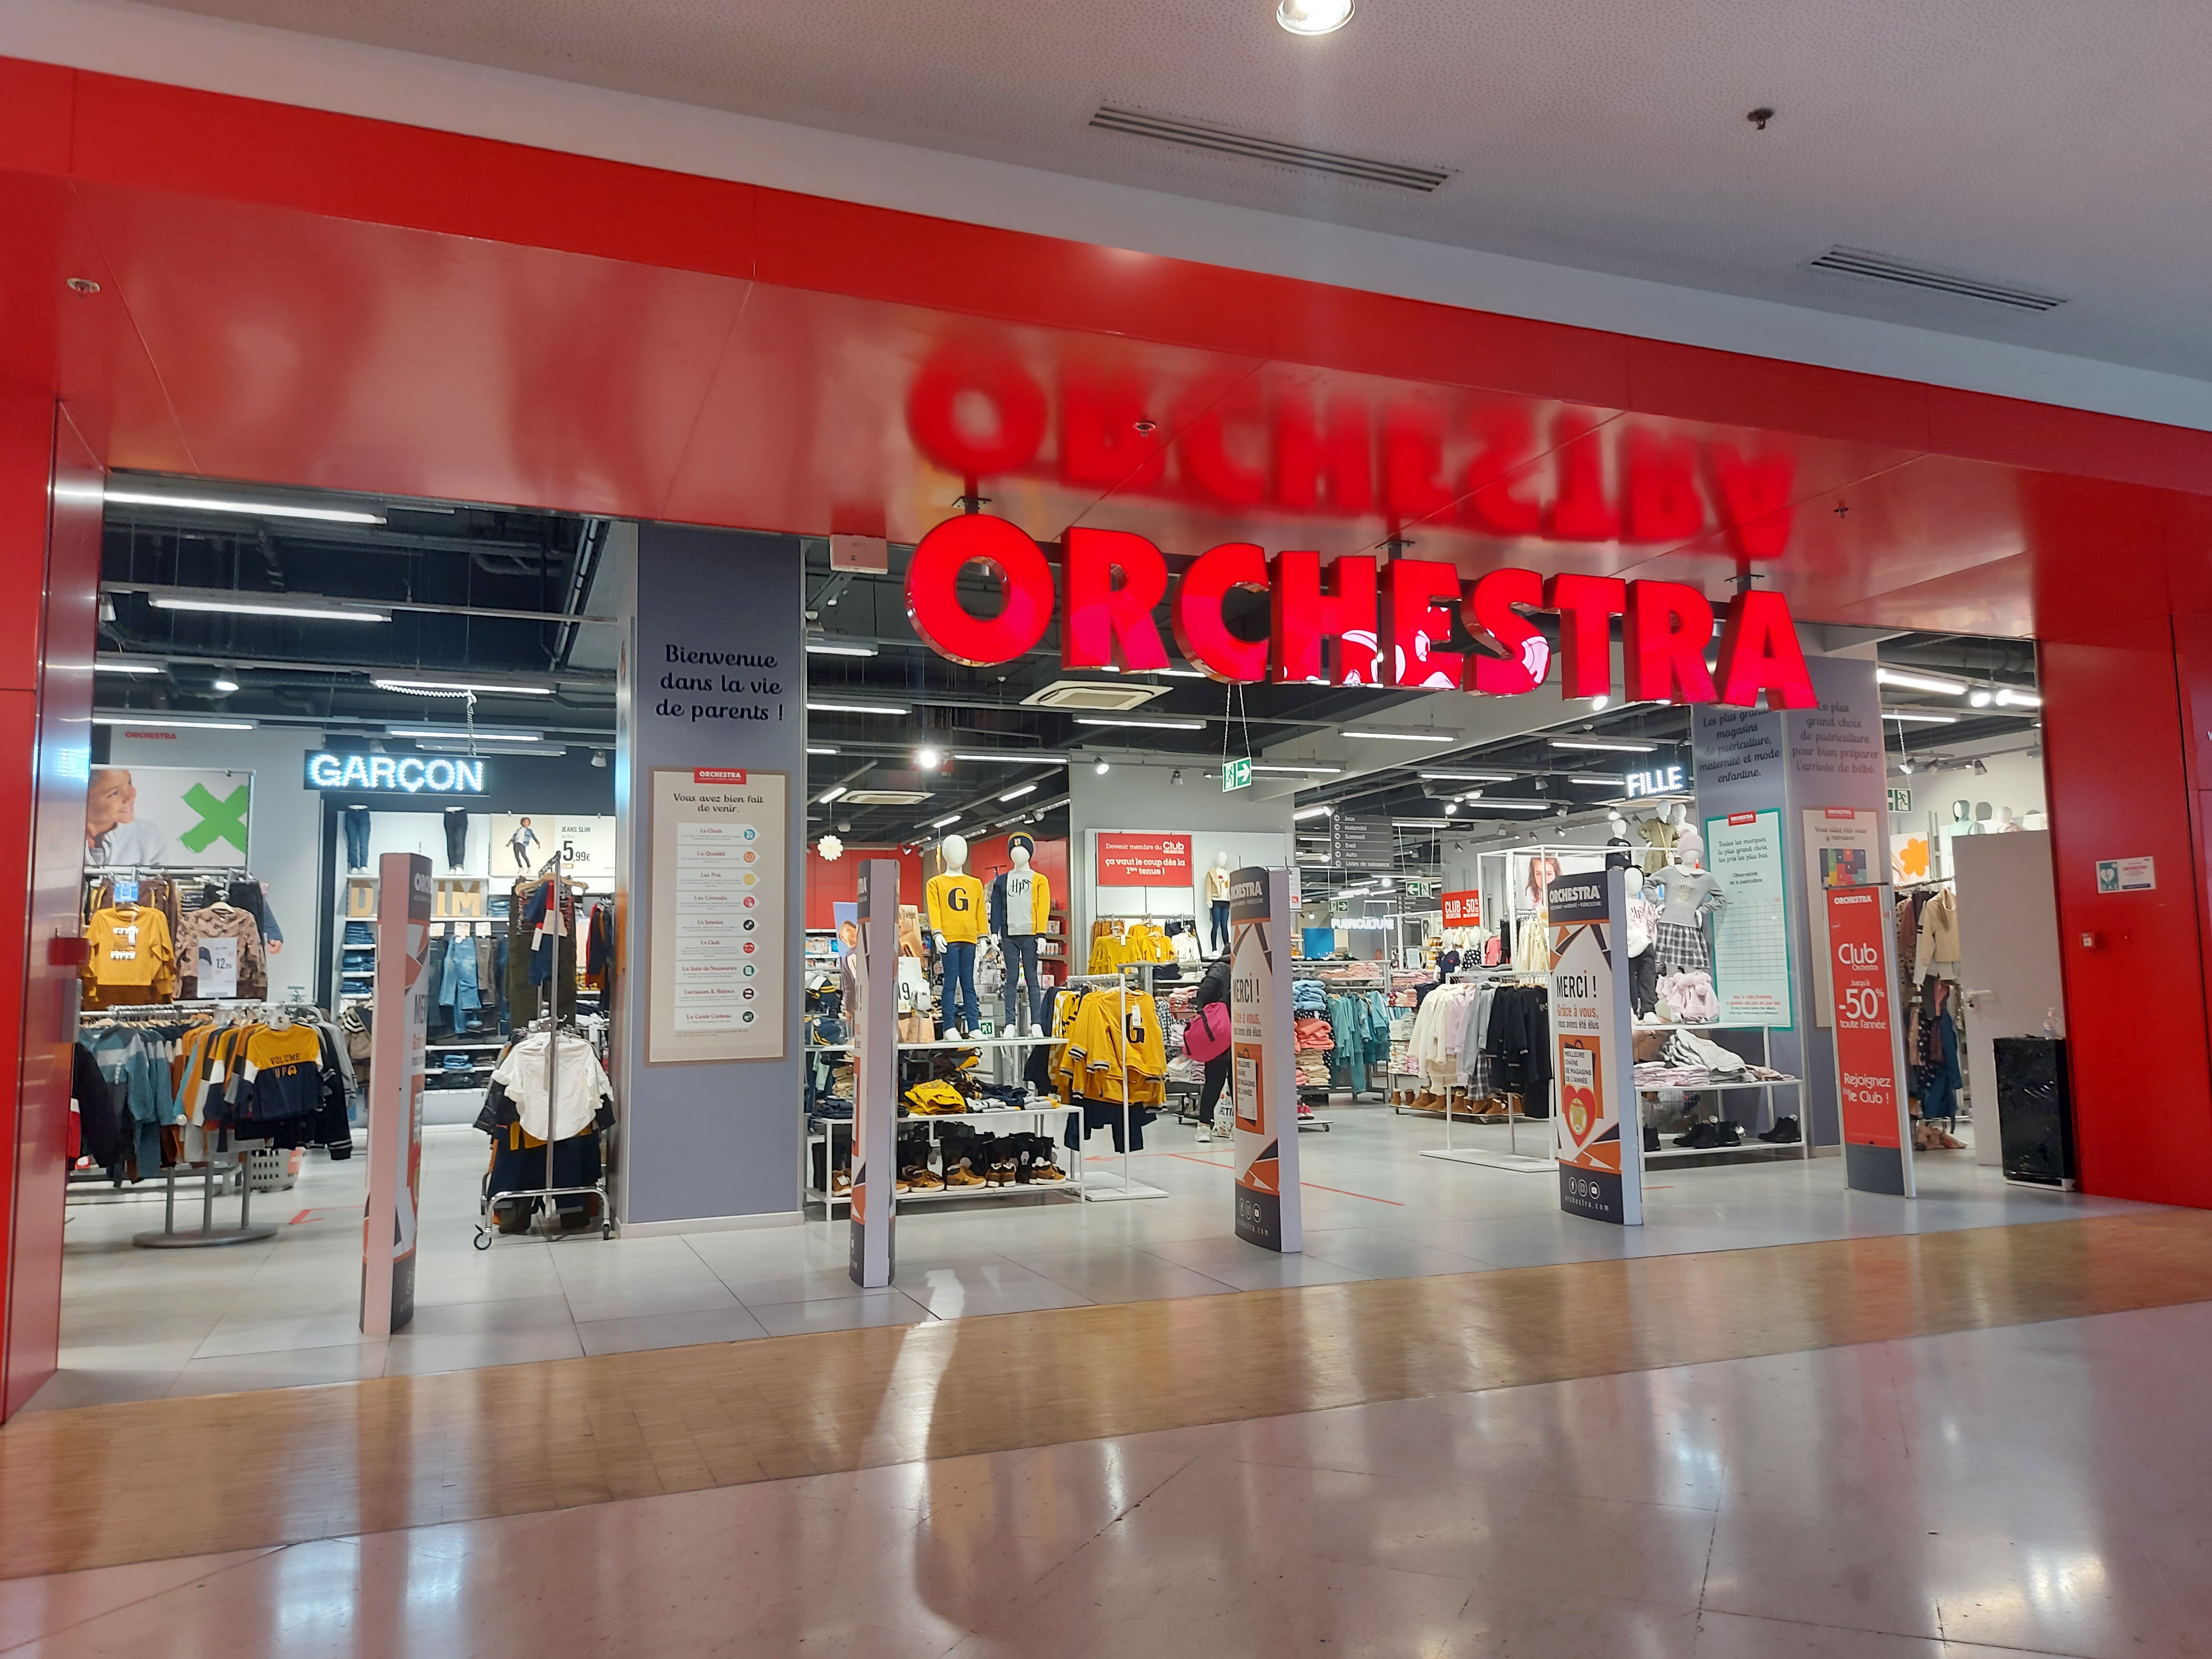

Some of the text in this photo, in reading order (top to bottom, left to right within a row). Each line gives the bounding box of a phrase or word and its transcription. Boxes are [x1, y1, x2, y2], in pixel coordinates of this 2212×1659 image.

[906, 512, 1819, 711] ORCHESTRA
[665, 644, 778, 668] Bienvenue
[660, 672, 783, 694] dans la vie
[656, 698, 783, 722] de parents !
[1831, 702, 1849, 713] plus
[1703, 717, 1716, 728] Les
[1719, 713, 1736, 726] plus
[1806, 717, 1862, 728] grand choix
[1716, 723, 1758, 739] magasins
[1800, 730, 1870, 743] de puériculture
[1704, 737, 1772, 756] de puériculture,
[1792, 746, 1879, 761] pour bien préparer
[1699, 748, 1781, 772] maternité et mode
[1796, 760, 1877, 774] l'arrivée de bébé.
[309, 754, 483, 793] GARÇON
[699, 771, 741, 779] ORCHESTRA
[1718, 769, 1761, 783] enfantine.
[1627, 766, 1683, 798] FILLE
[673, 793, 696, 802] Vous
[724, 795, 744, 803] bien
[747, 795, 764, 803] fait
[697, 804, 740, 813] de venir.
[563, 841, 591, 863] 5,99€
[1162, 841, 1185, 850] Club
[1736, 845, 1752, 854] grand
[1105, 859, 1115, 867] ça
[1143, 859, 1162, 868] coup
[1163, 857, 1177, 866] dès
[1177, 858, 1185, 866] la
[1746, 853, 1757, 862] plus
[1139, 867, 1161, 875] tenue
[948, 887, 969, 912] G
[1549, 885, 1601, 904] ORCHESTRA
[1834, 895, 1872, 905] ORCHESTRA
[1445, 897, 1479, 914] CLUB -50%
[1838, 942, 1878, 965] Club
[1593, 975, 1597, 998] !
[1838, 987, 1885, 1020] -50%
[1557, 1004, 1599, 1019] Grâce à vous,
[1126, 1013, 1145, 1044] G
[1579, 1019, 1587, 1029] été
[1588, 1019, 1599, 1029] élus
[1840, 1019, 1887, 1029] toute l'année
[270, 1053, 300, 1065] VOLUME
[275, 1066, 287, 1079] UP
[1844, 1073, 1891, 1090] Rejoignez
[1847, 1090, 1890, 1105] le Club !
[1565, 1195, 1610, 1212] orchestra.com
